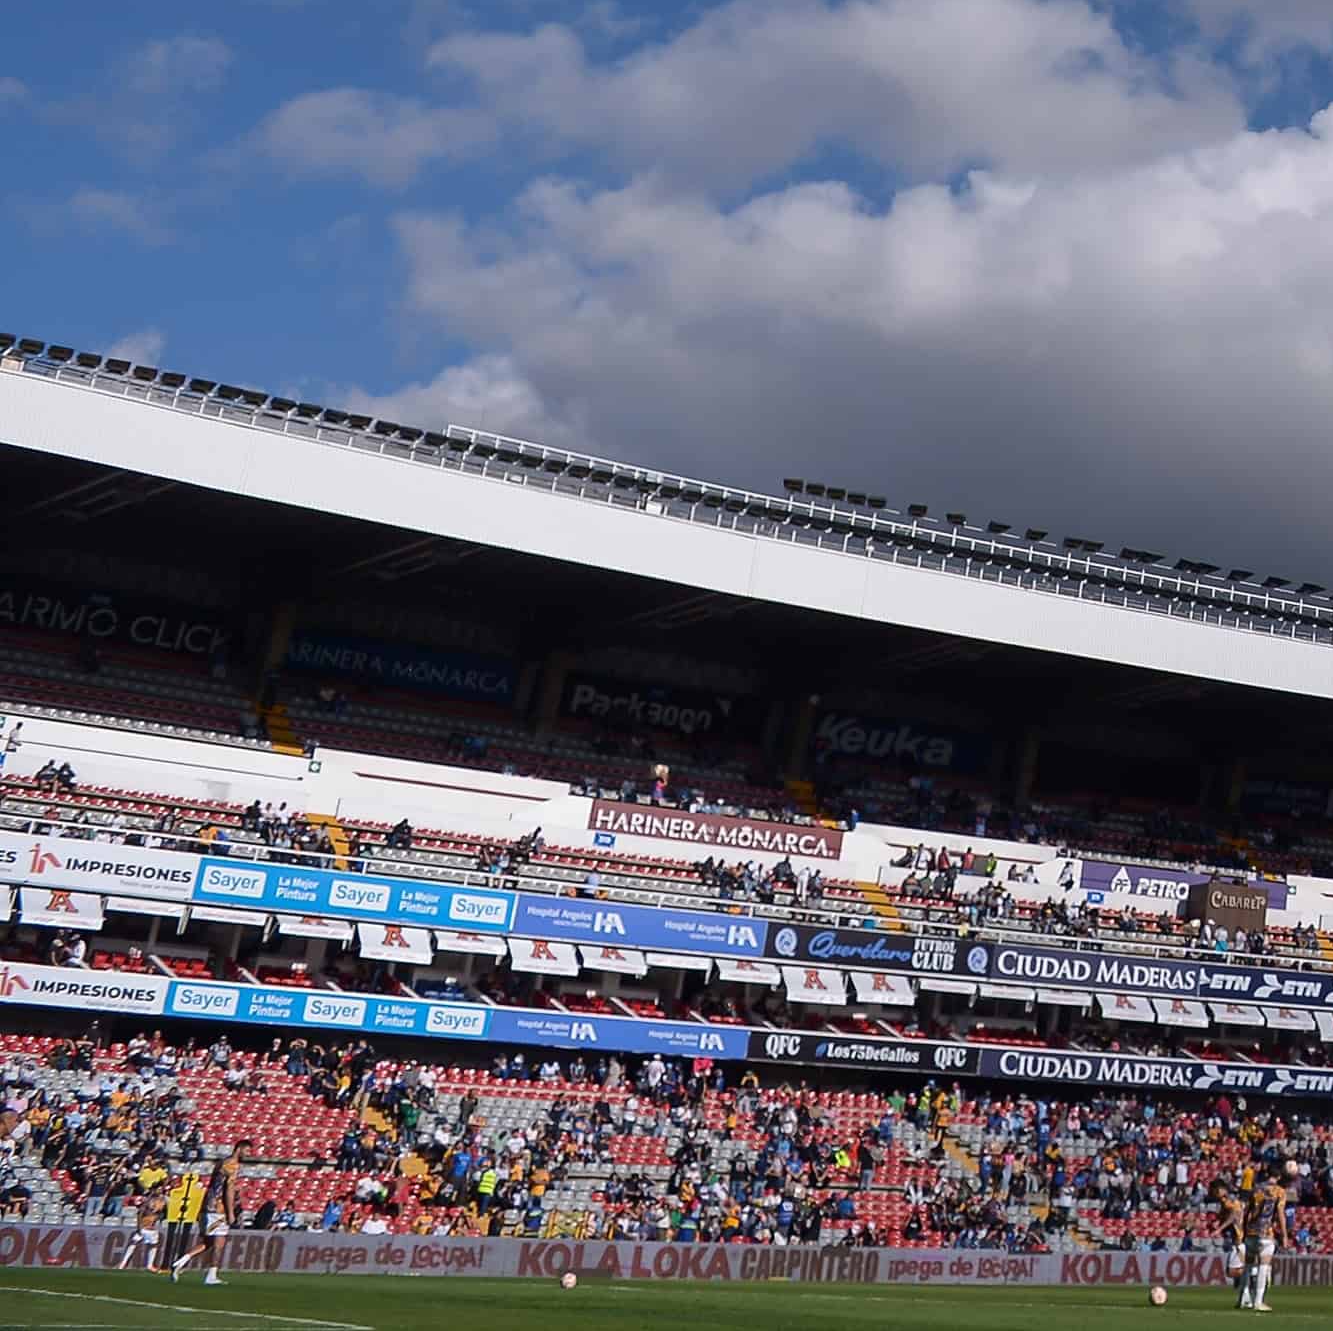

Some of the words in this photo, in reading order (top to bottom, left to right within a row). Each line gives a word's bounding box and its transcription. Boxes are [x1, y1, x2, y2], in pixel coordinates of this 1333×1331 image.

[595, 809, 709, 843] HARINERA
[65, 857, 193, 884] IMPRESIONES
[208, 870, 259, 891] Sayer
[335, 885, 384, 906] Sayer
[1136, 877, 1189, 901] PETRO
[455, 898, 501, 918] Sayer
[997, 950, 1091, 981] CIUDAD
[1096, 960, 1196, 991] MADERAS
[1209, 973, 1251, 991] ETN
[33, 979, 156, 1002] IMPRESIONES
[180, 989, 233, 1009] Sayer
[1281, 980, 1322, 998] ETN
[310, 1000, 360, 1021] Sayer
[432, 1010, 479, 1031] Sayer
[765, 1034, 801, 1059] QFC
[933, 1046, 967, 1070] QFC
[999, 1051, 1092, 1080] CIUDAD
[1222, 1070, 1264, 1087] ETN
[1294, 1075, 1333, 1092] ETN
[375, 1243, 404, 1266] de
[517, 1242, 624, 1279] KOLA
[632, 1243, 731, 1281] LOKA
[950, 1256, 973, 1276] de
[1060, 1254, 1143, 1284] KOLA
[1150, 1252, 1228, 1284] LOKA
